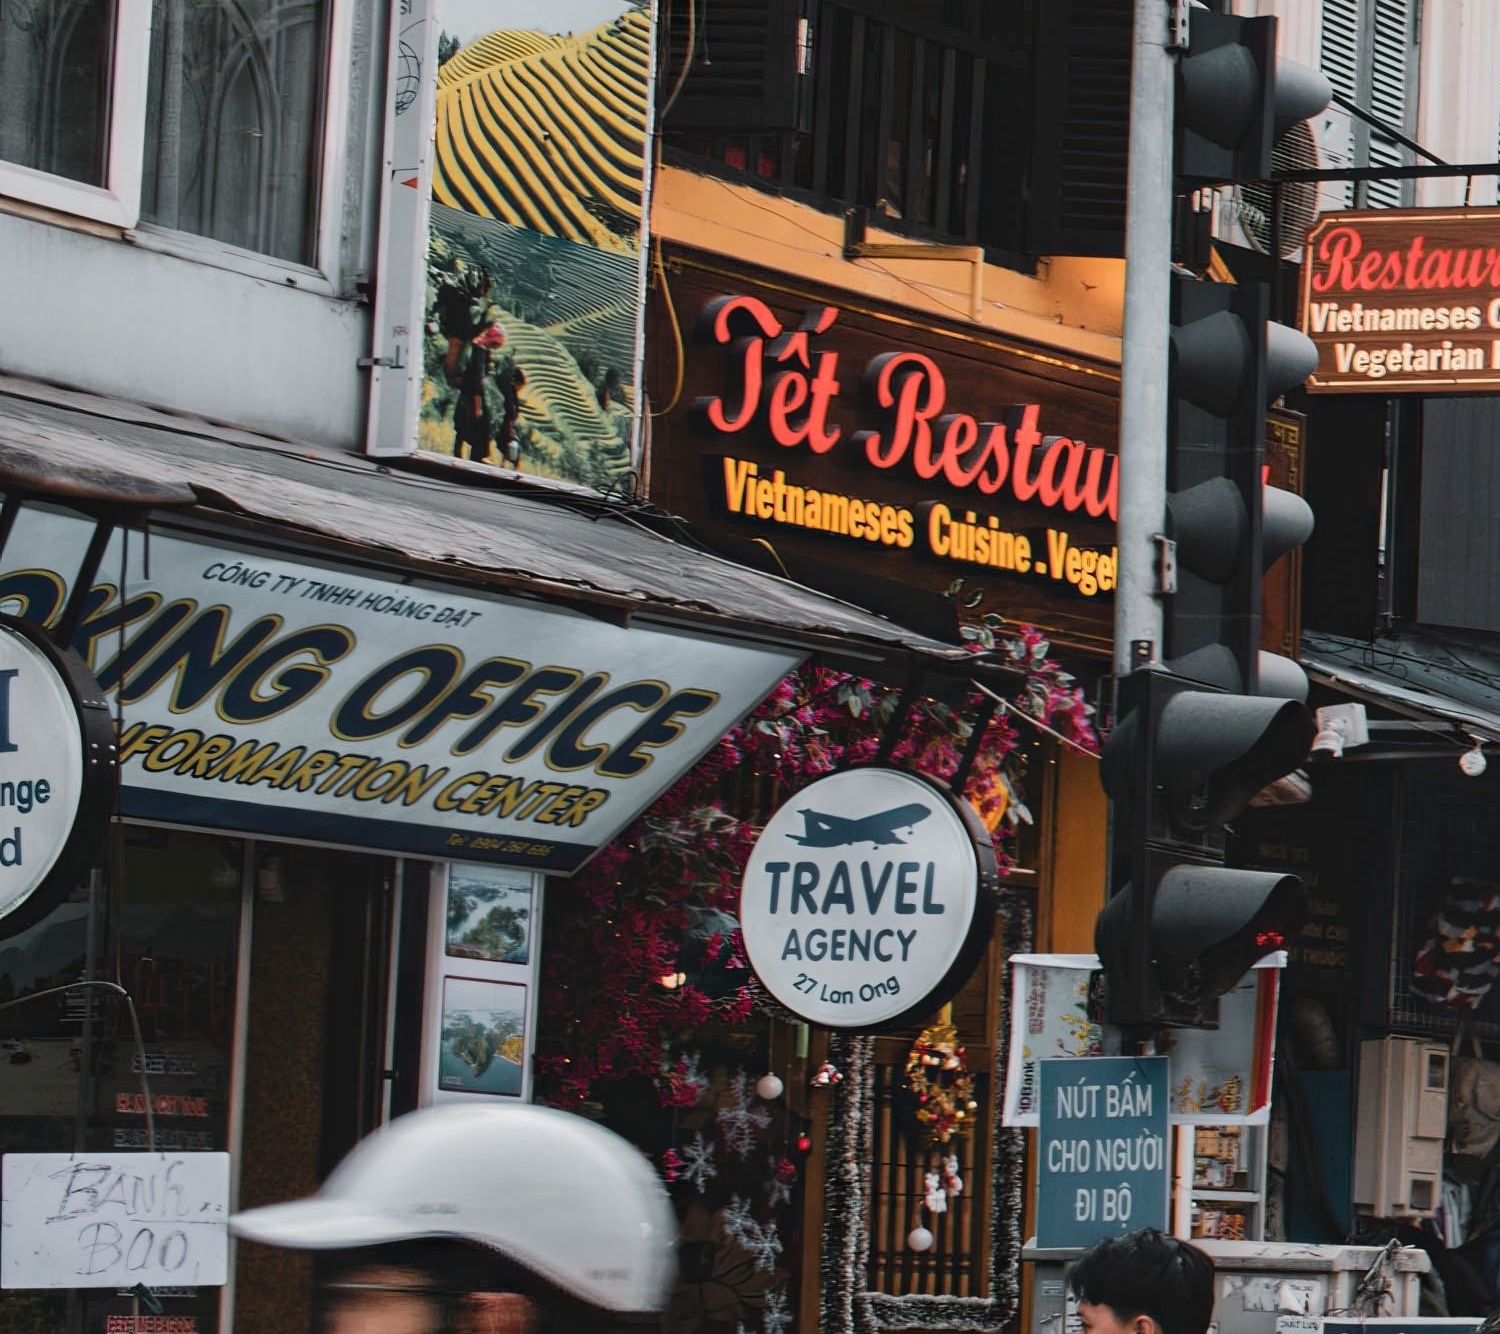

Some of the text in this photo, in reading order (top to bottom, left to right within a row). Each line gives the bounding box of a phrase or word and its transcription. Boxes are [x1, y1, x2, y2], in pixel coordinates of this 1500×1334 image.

[1310, 302, 1481, 333] Vietnameses
[708, 295, 842, 454] Tết
[1334, 341, 1484, 378] Vegetarian
[723, 457, 1031, 574] Vietnameses Cuisine
[201, 559, 268, 593] CÔNG
[272, 576, 305, 600] TY
[301, 581, 363, 611] TNHH
[431, 603, 483, 632] ĐẠT
[331, 642, 720, 780] OFFICE
[435, 771, 610, 830] CENTER
[765, 860, 946, 916] TRAVEL
[781, 928, 917, 962] AGENCY
[792, 972, 901, 1004] 27 Lan Ong
[1056, 1070, 1153, 1119] NÚT BẤM
[1048, 1127, 1164, 1173] CHO NGƯỜI
[1075, 1182, 1133, 1228] ĐI BỘ
